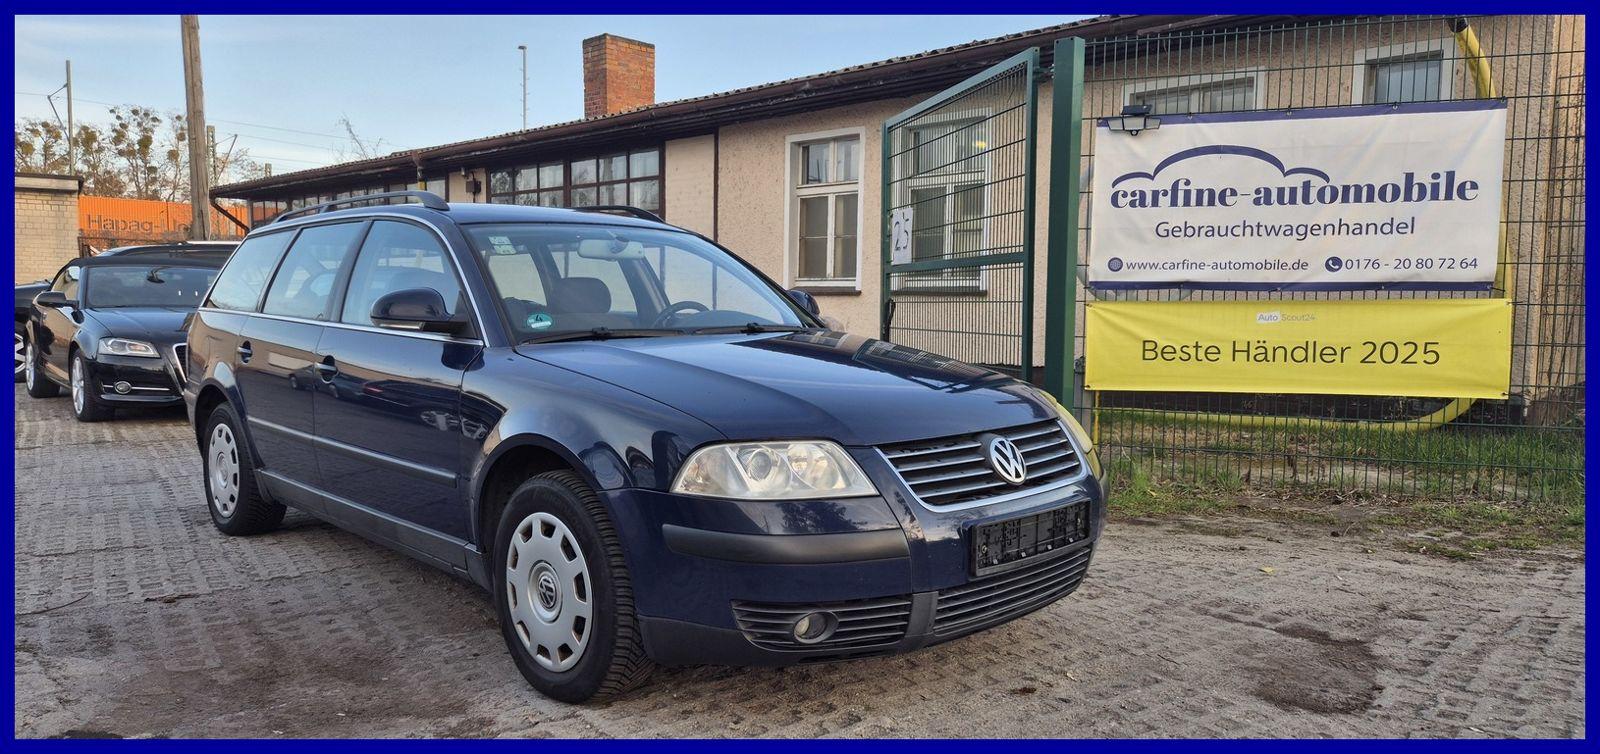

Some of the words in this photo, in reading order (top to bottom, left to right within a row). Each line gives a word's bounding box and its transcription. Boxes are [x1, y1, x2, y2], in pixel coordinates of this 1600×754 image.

[1110, 170, 1479, 209] carfine-automobile
[1155, 216, 1415, 241] Gebrauchtwagenhandel
[1126, 258, 1309, 271] www.carfine-automobile.de
[1345, 258, 1381, 270] 0176
[1394, 258, 1412, 270] 20
[1415, 258, 1434, 270] 80
[1438, 257, 1456, 270] 72
[1459, 257, 1478, 269] 64
[1258, 313, 1279, 321] Auto
[1142, 339, 1221, 362] Beste
[1232, 340, 1352, 363] Händler
[1360, 341, 1440, 365] 2025
